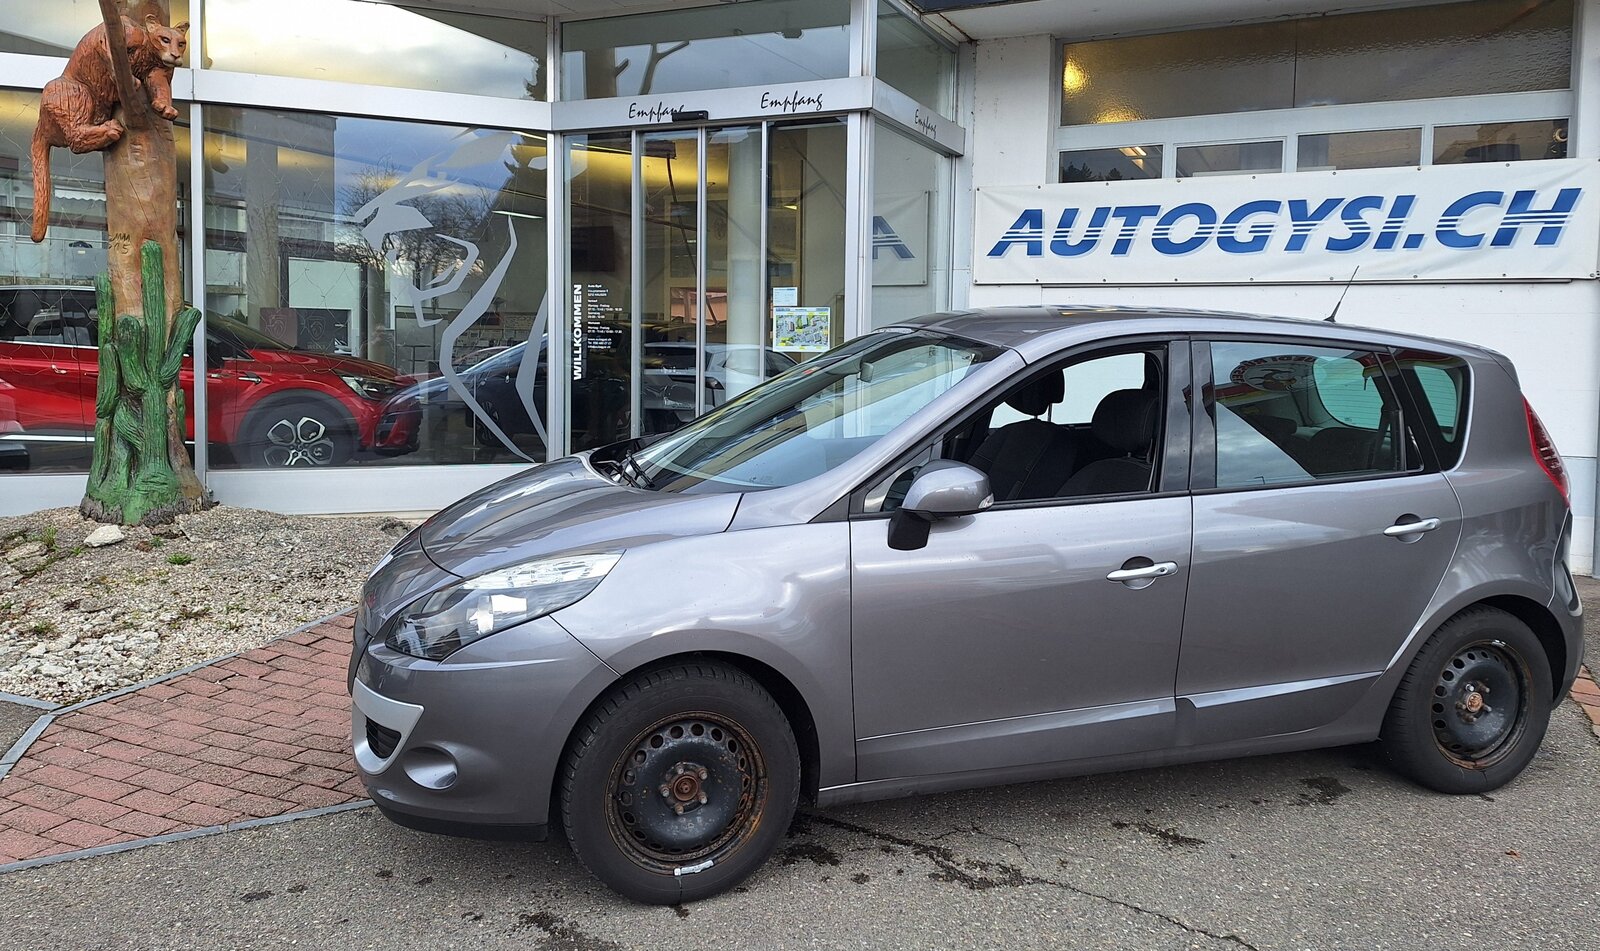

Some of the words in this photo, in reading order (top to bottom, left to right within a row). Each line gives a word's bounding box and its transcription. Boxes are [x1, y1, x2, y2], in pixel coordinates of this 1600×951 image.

[760, 90, 823, 112] Empfang
[914, 108, 937, 140] Empfang
[987, 188, 1582, 257] AUTOGYSI.CH
[573, 284, 582, 381] WILLKOMMEN
